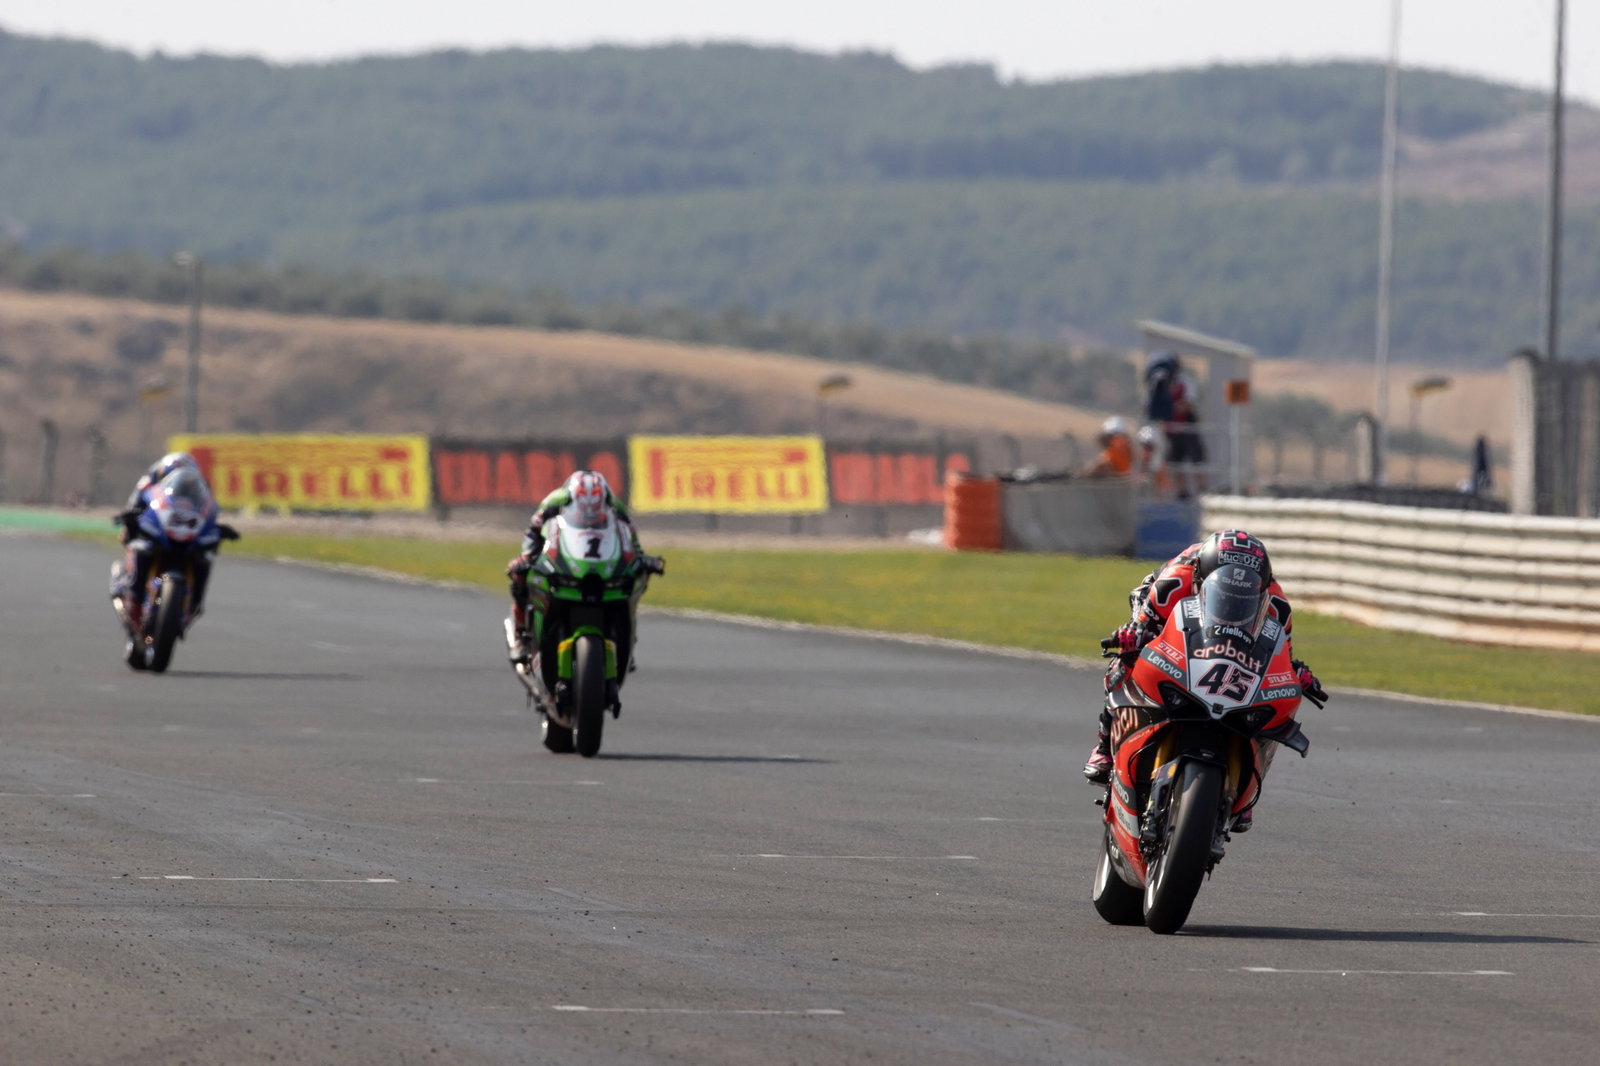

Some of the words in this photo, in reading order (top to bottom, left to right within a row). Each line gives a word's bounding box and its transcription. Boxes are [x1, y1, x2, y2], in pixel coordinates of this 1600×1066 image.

[583, 537, 602, 559] 1
[1222, 577, 1252, 589] SHARK
[1222, 625, 1243, 638] riello
[1147, 651, 1183, 679] Lenovo
[1193, 639, 1263, 673] aruba.it
[1195, 662, 1257, 704] 45
[1261, 687, 1297, 700] Lenovo
